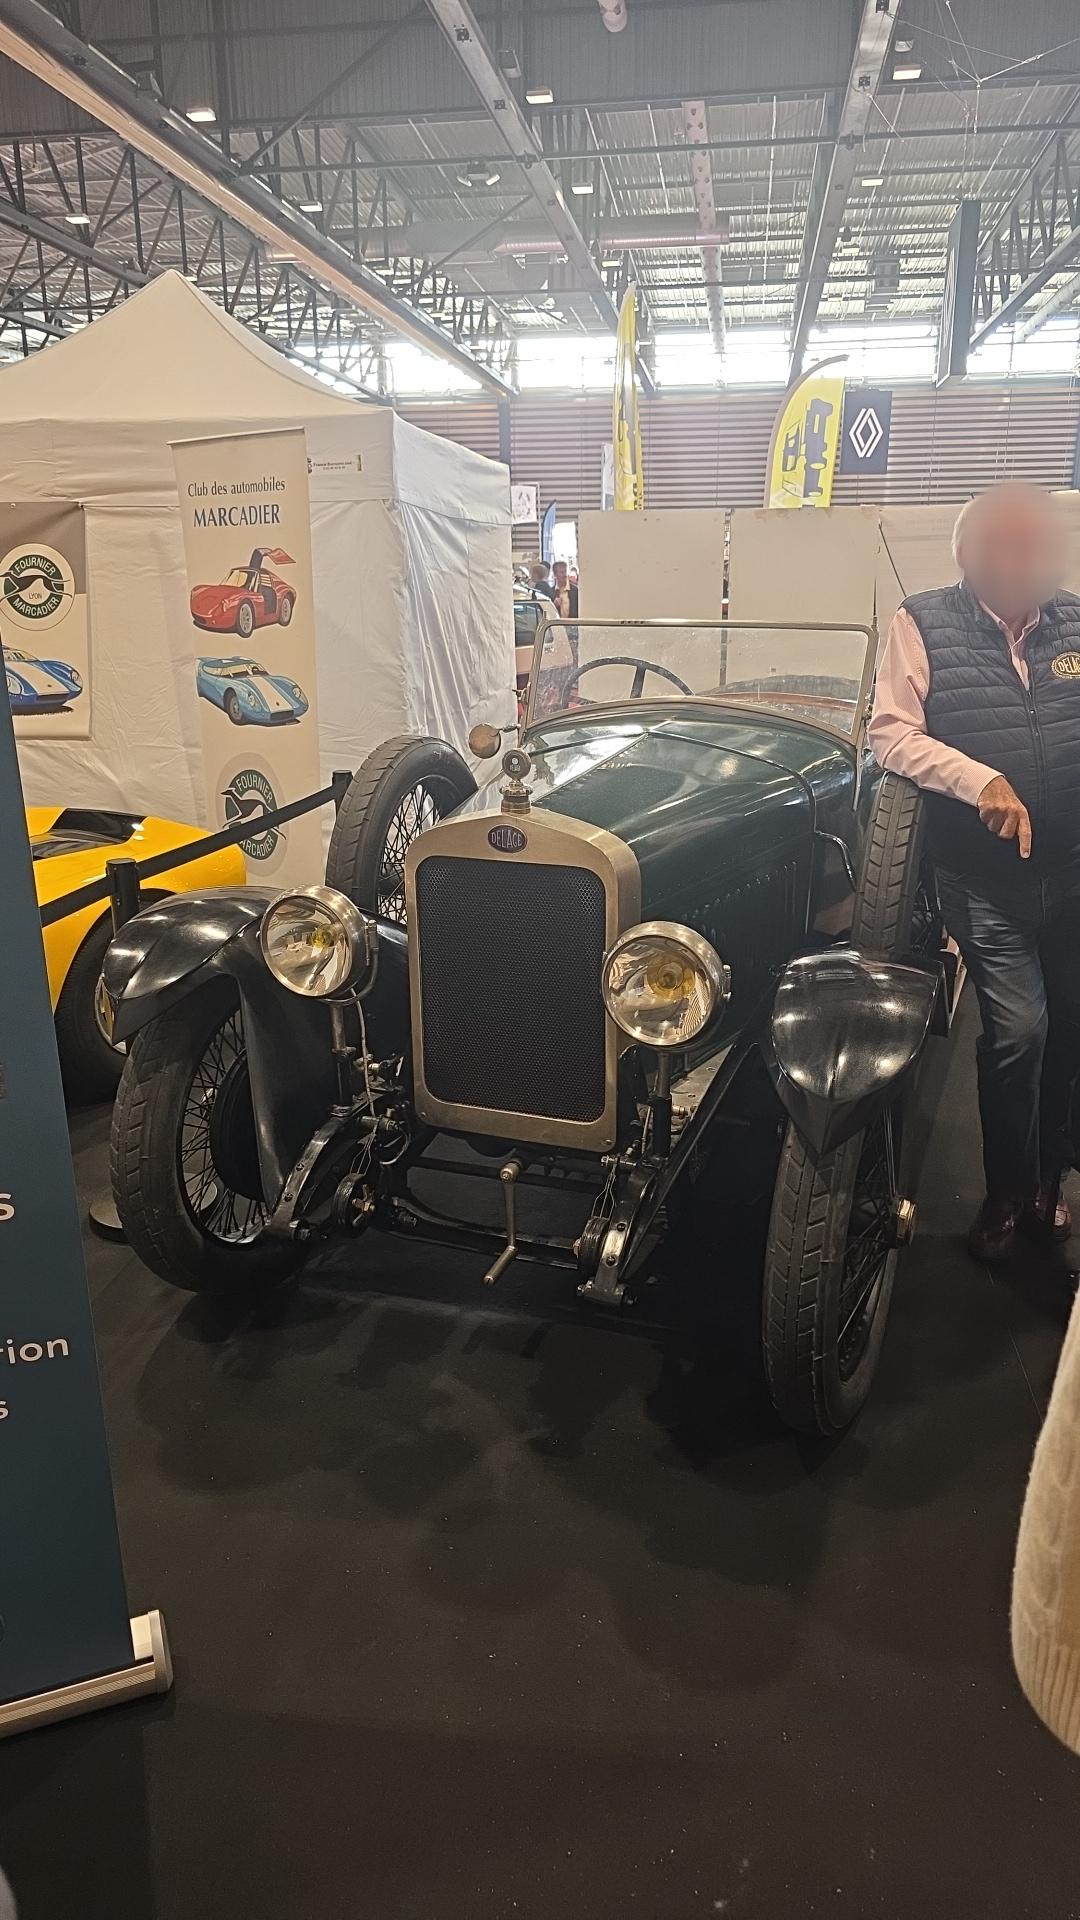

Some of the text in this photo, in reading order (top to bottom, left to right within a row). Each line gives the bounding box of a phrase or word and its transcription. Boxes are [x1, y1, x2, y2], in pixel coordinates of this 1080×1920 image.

[187, 476, 286, 497] Club des automobiles
[193, 504, 280, 527] MARCADIER
[14, 556, 56, 576] FOURNIER
[12, 596, 60, 616] MARCADIER
[235, 774, 273, 803] FOURNIER
[239, 834, 274, 857] ARCADIER
[491, 829, 523, 848] DELAGE
[0, 1338, 69, 1364] ion
